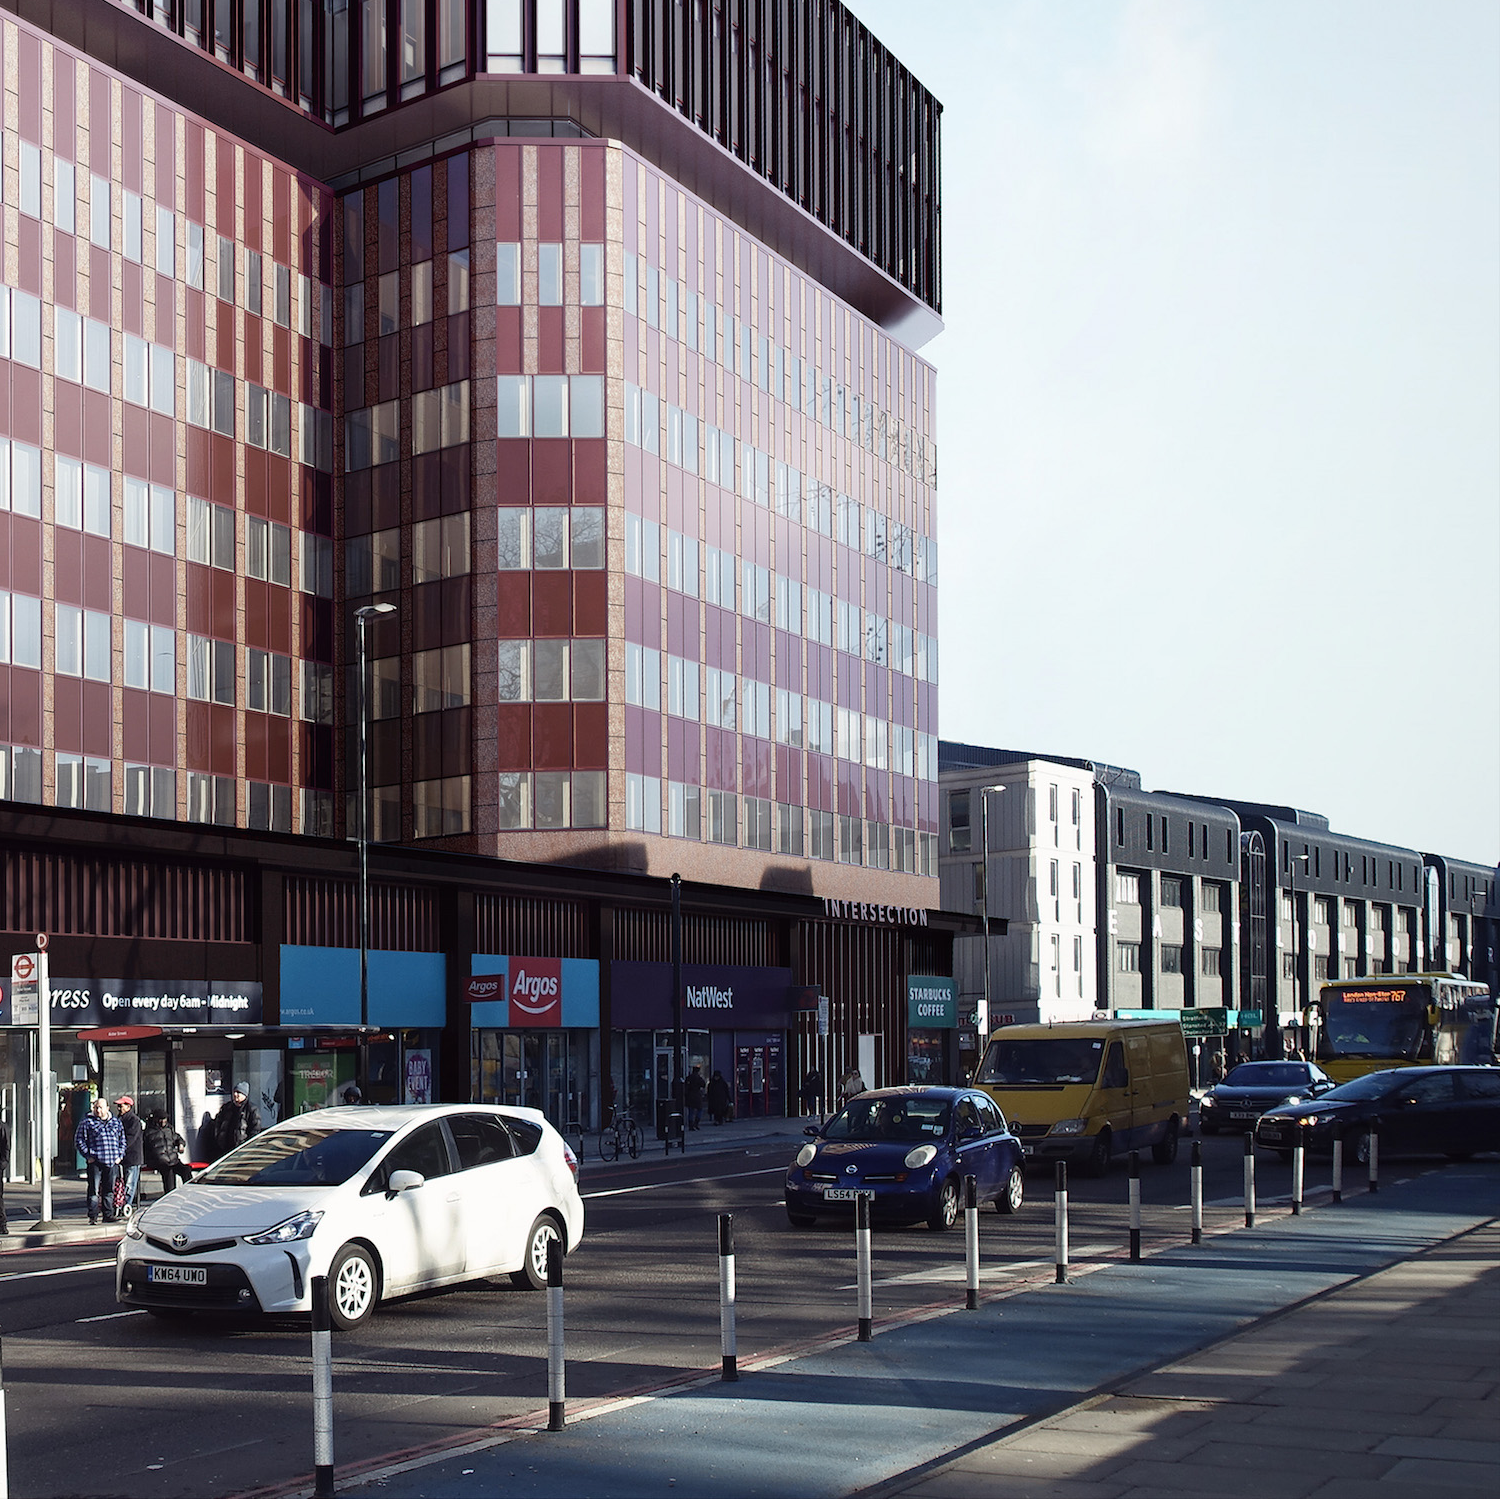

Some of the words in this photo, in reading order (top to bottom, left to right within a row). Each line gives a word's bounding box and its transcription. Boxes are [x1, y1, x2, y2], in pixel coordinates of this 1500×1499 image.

[824, 898, 928, 927] INTERSECTION
[37, 933, 47, 948] D
[468, 980, 498, 993] Argos
[513, 969, 558, 1003] Argos
[102, 992, 131, 1010] Open
[132, 996, 161, 1011] every
[160, 994, 180, 1010] day
[180, 994, 201, 1009] 6am
[207, 994, 249, 1011] Midnight
[686, 985, 733, 1009] NatWest
[909, 987, 952, 1001] STARBUCKS
[1391, 990, 1406, 1002] 767
[917, 1003, 945, 1016] COFFEE
[299, 1069, 333, 1079] TREBOR
[408, 1060, 426, 1075] BABY
[407, 1076, 429, 1091] EVENT
